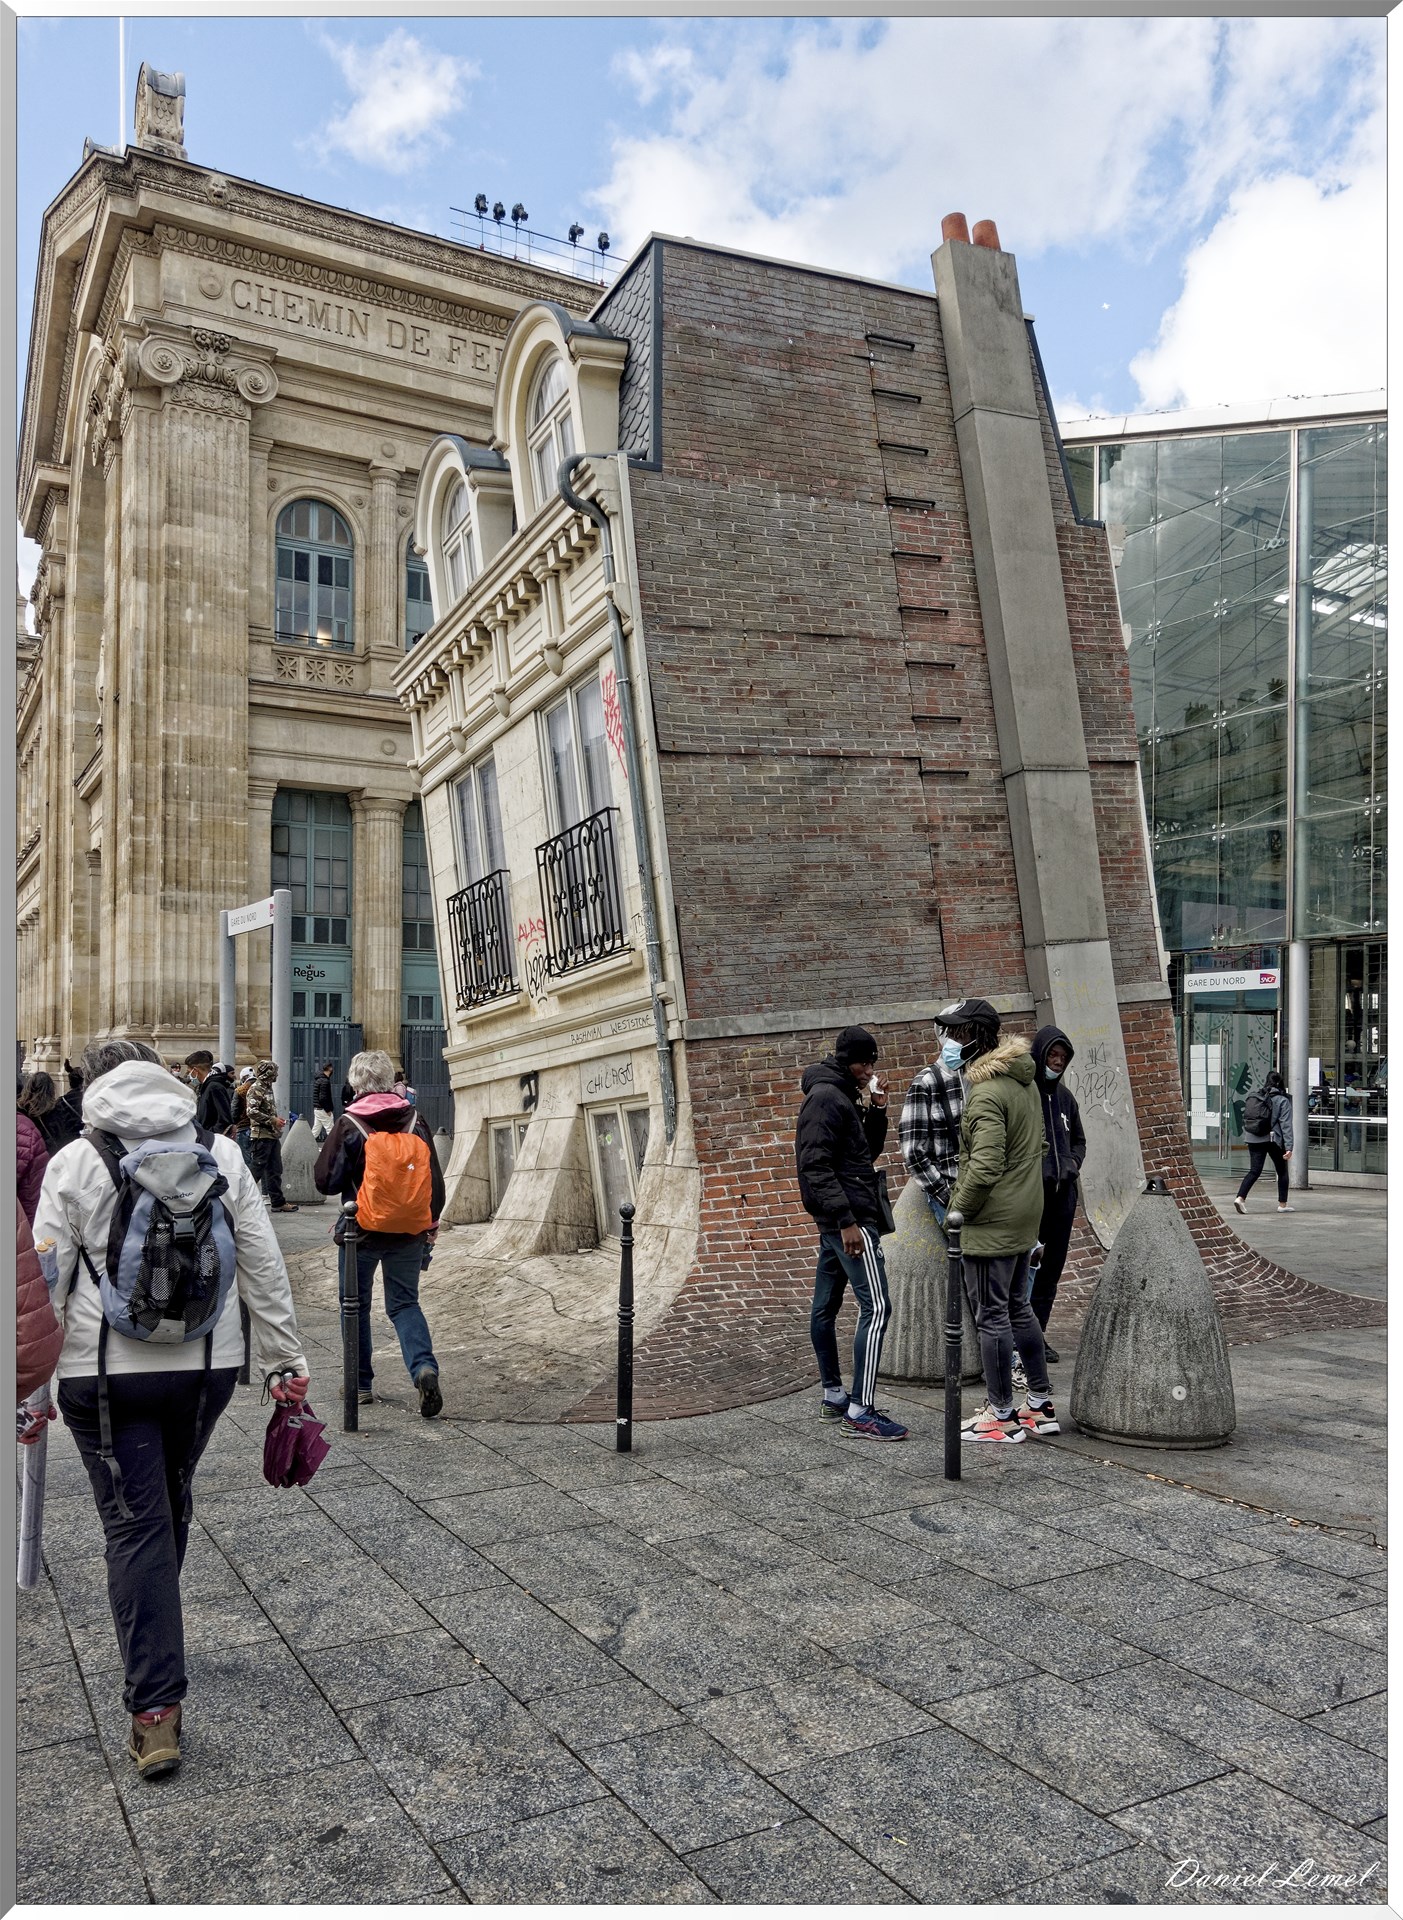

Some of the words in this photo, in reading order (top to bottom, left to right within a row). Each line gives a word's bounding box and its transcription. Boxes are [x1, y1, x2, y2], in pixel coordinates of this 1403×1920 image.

[230, 278, 370, 339] CHEMIN
[386, 318, 431, 357] DE
[293, 966, 326, 982] Regus
[1260, 975, 1276, 984] SNCF
[1187, 978, 1208, 988] GARE
[1209, 977, 1221, 987] DU
[1222, 976, 1246, 986] NORD
